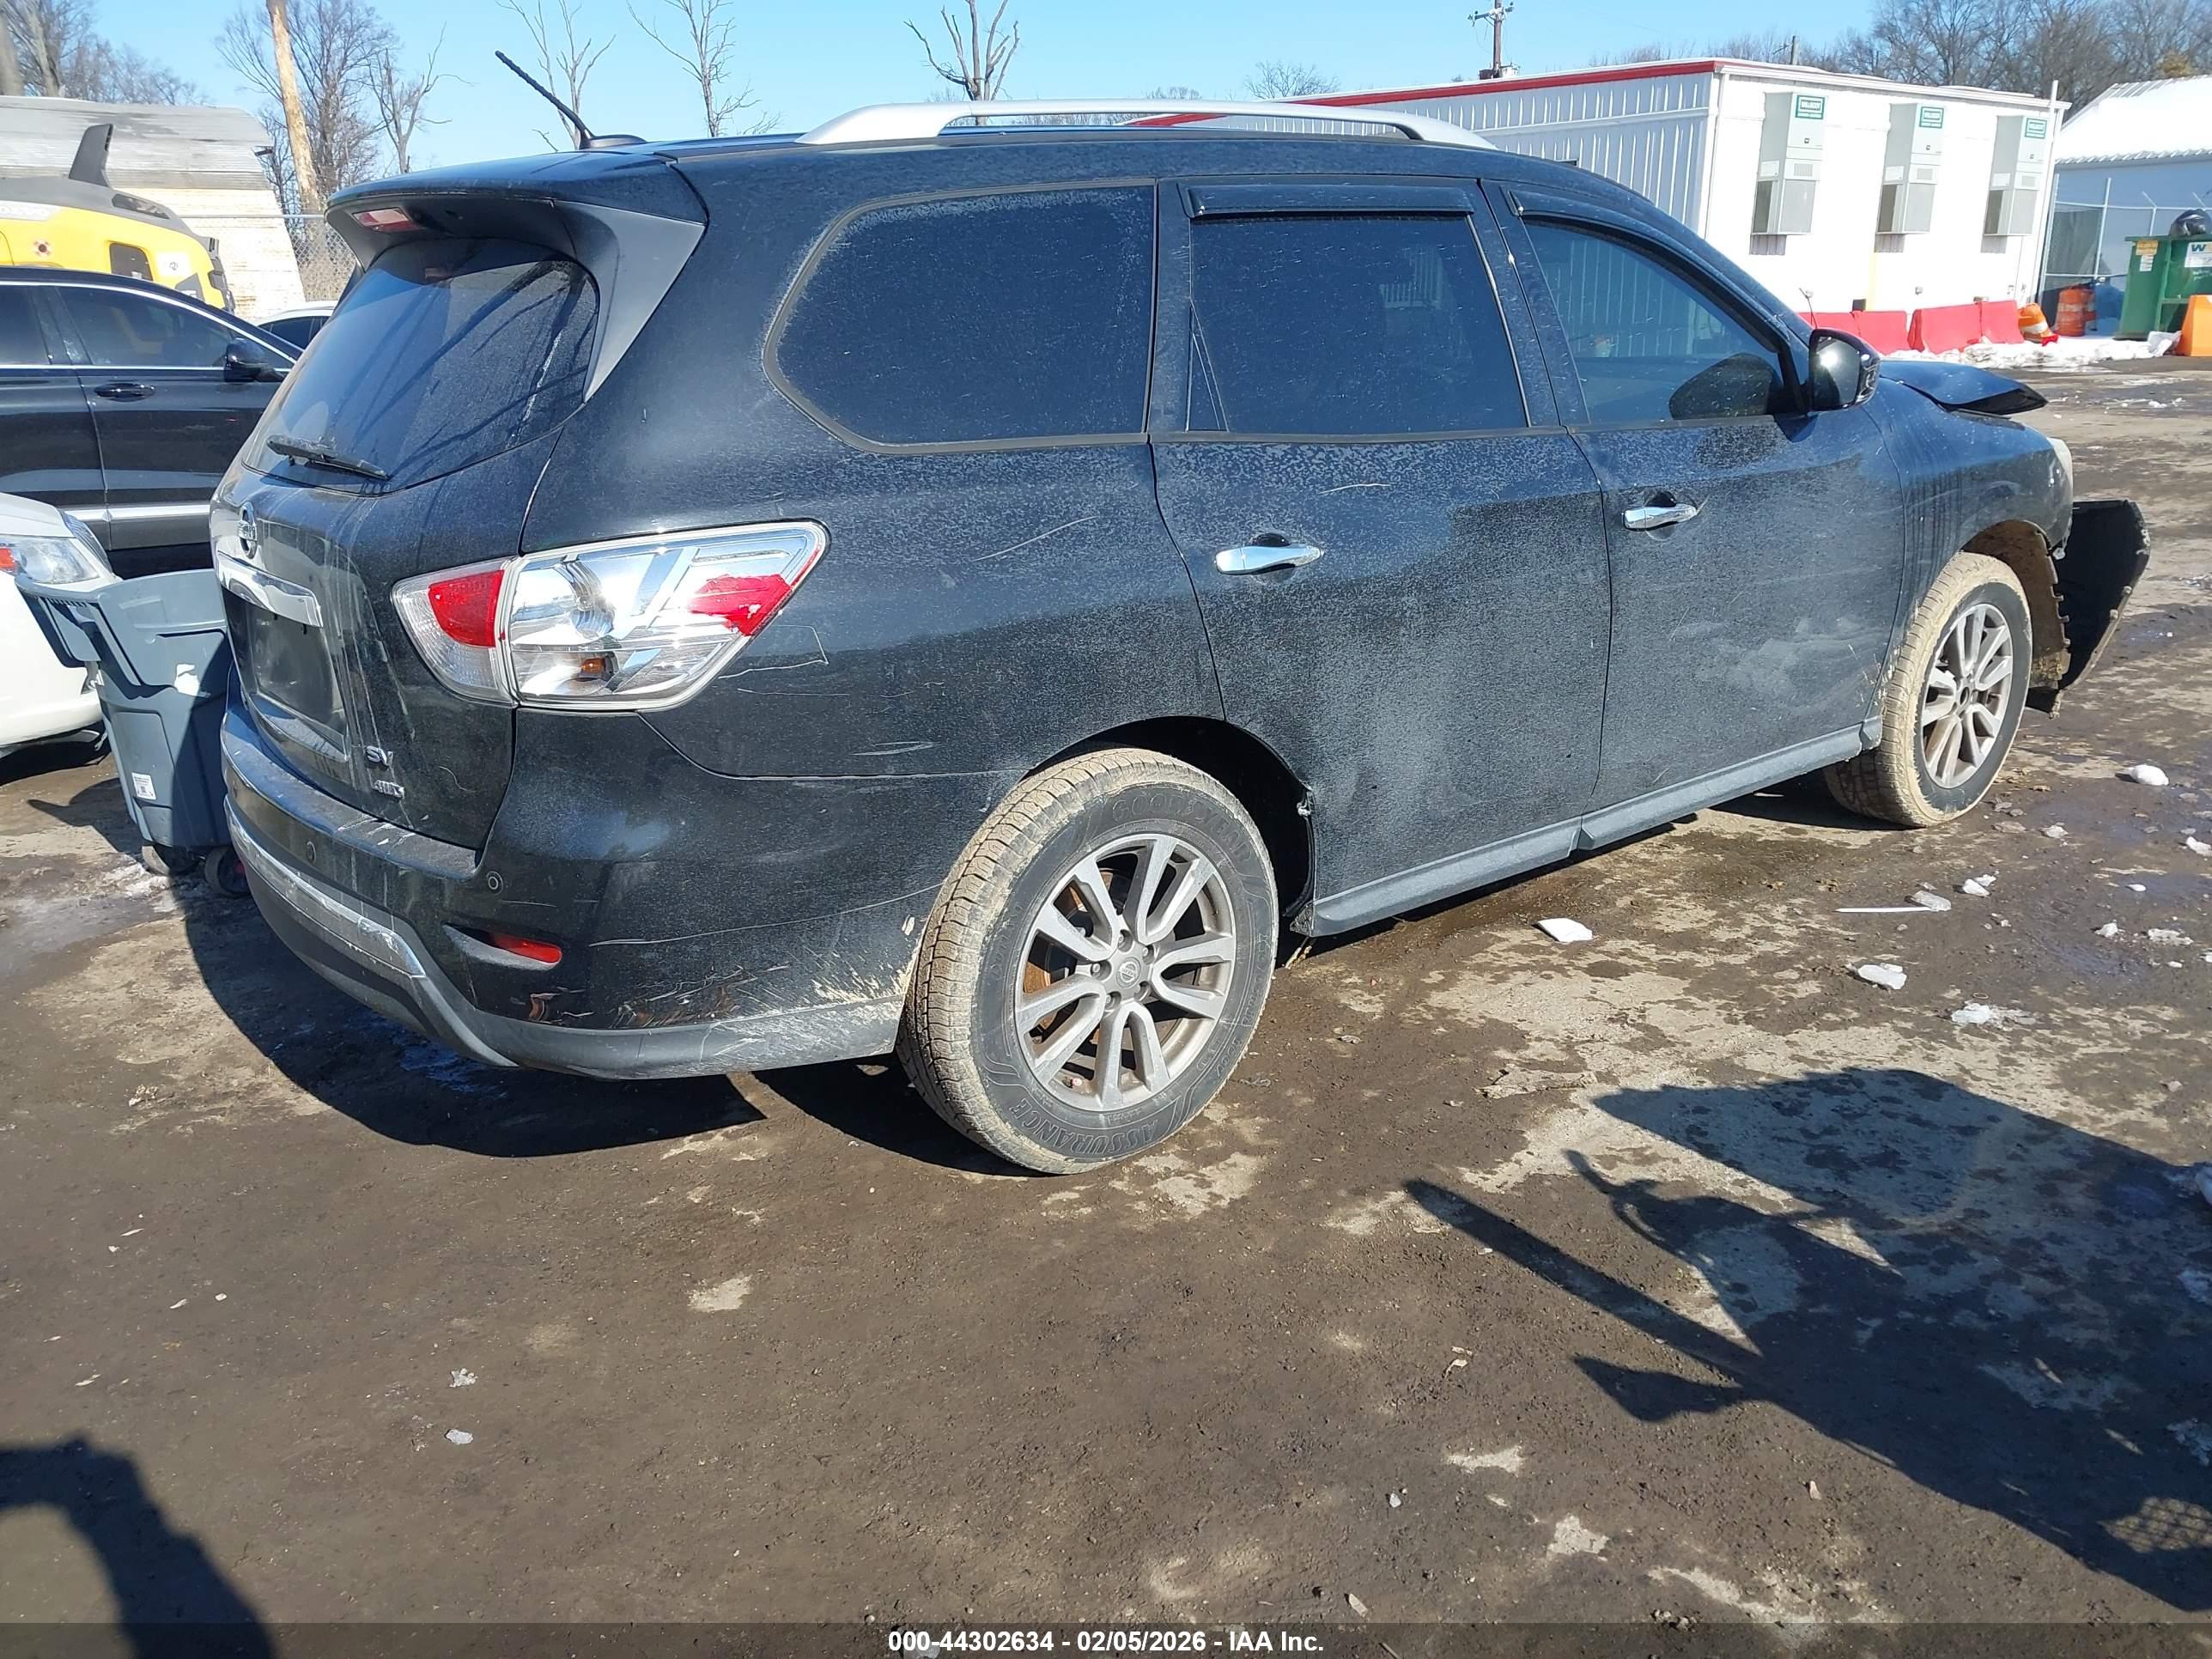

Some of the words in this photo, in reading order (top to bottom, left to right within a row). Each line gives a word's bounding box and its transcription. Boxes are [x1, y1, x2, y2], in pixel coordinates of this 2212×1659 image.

[367, 745, 394, 766] SV
[1112, 792, 1253, 866] GOODYEAR
[1008, 1097, 1158, 1155] ASSURANCE
